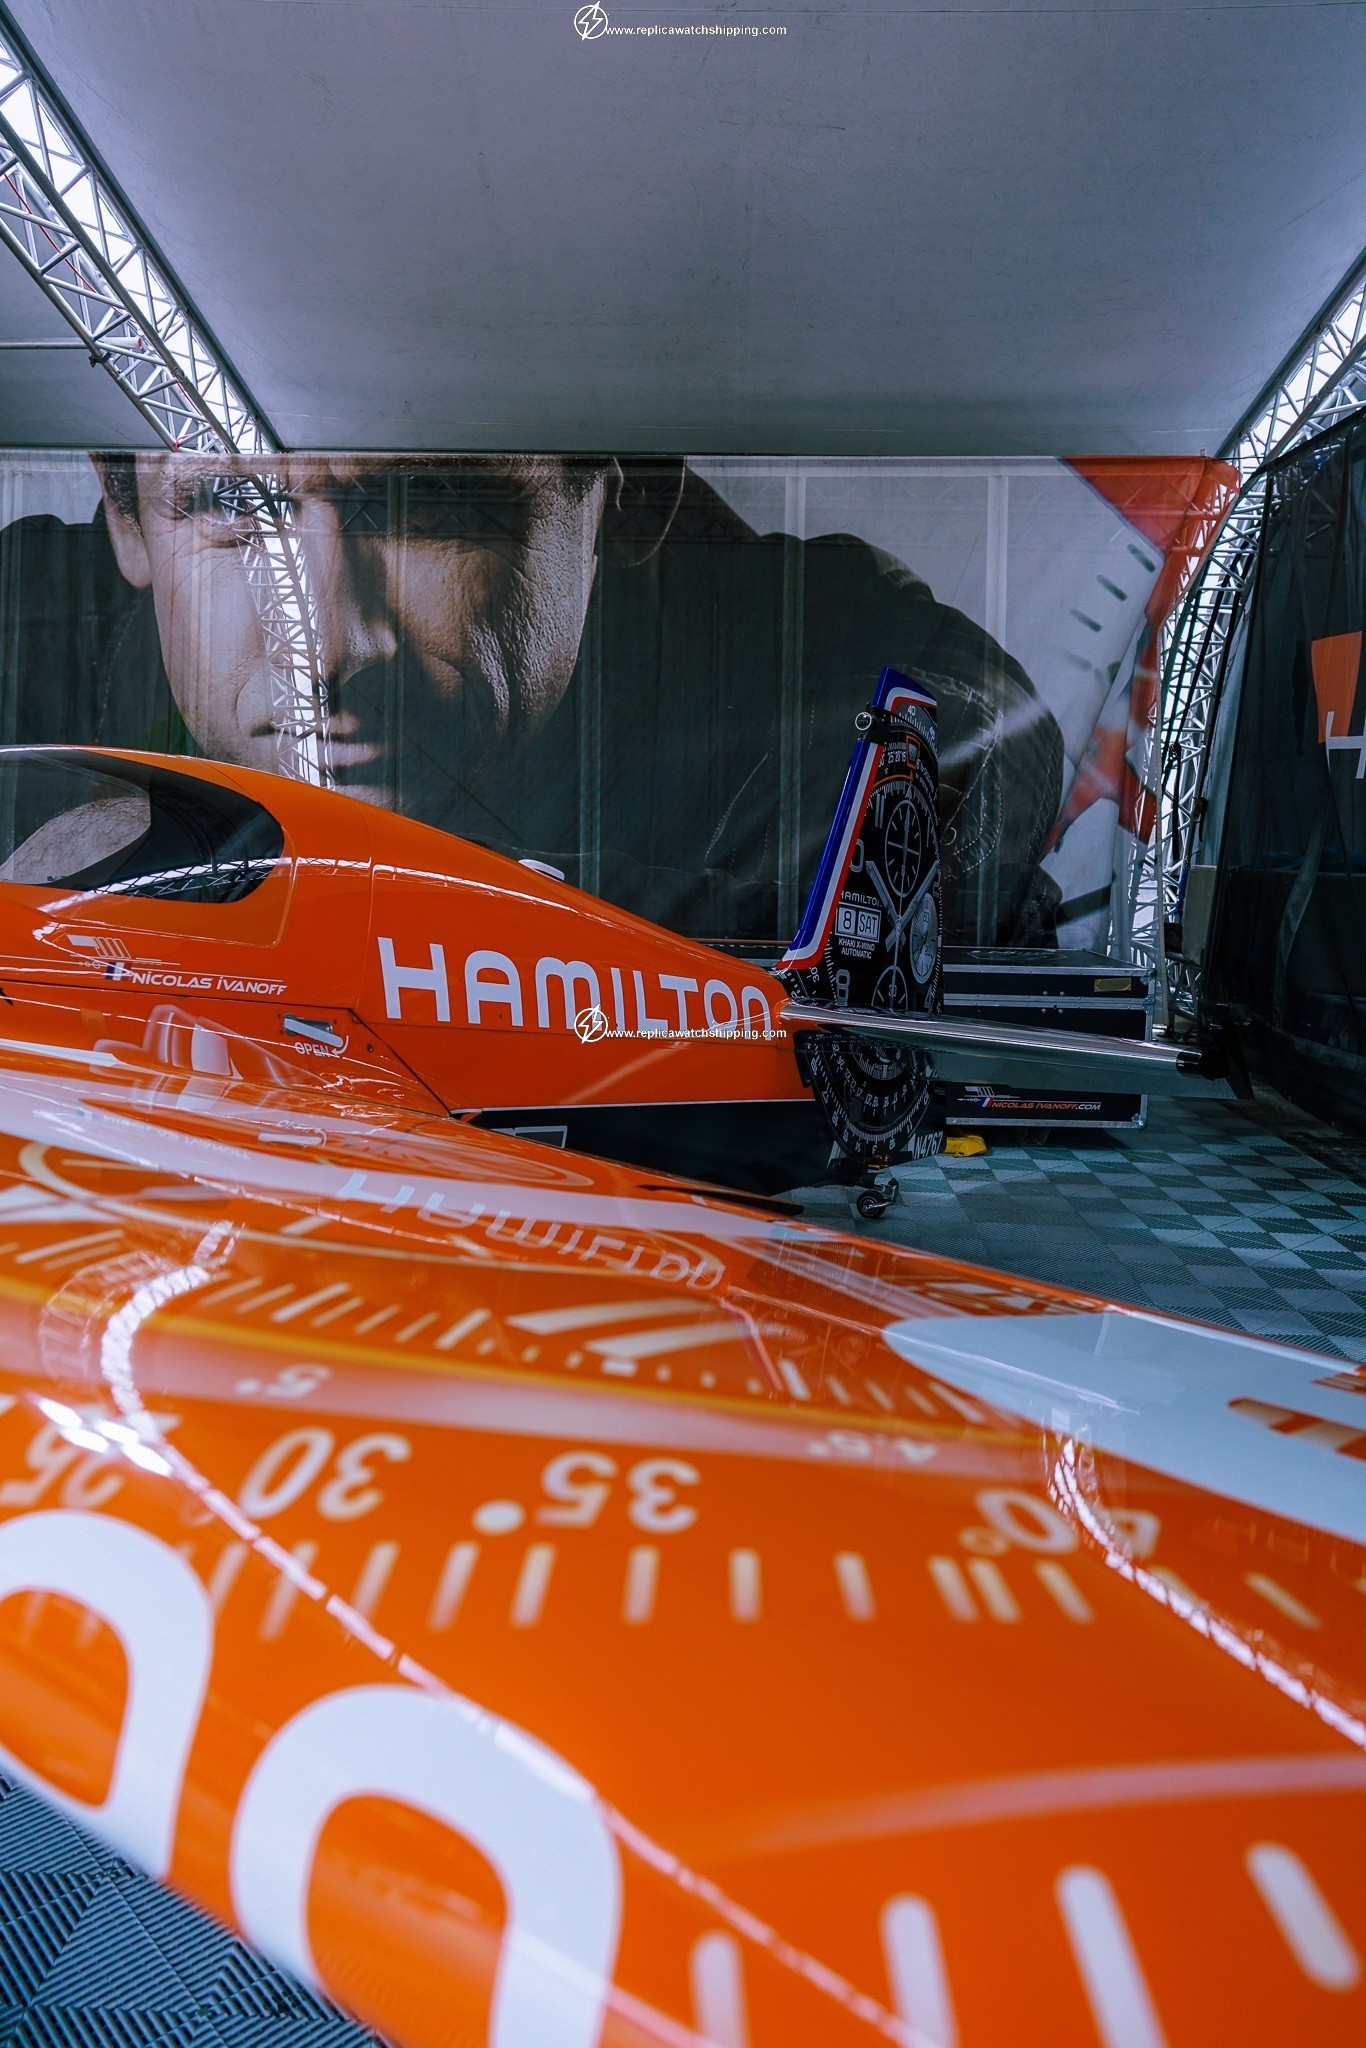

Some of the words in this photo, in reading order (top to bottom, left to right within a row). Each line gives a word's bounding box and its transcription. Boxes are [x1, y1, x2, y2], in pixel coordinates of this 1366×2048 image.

[843, 910, 852, 930] 8
[859, 914, 878, 935] SAT
[838, 938, 856, 948] KHAKI
[841, 947, 872, 960] AUTOMATIC
[131, 969, 212, 990] NICOLAS
[216, 975, 288, 996] IVANOFF
[377, 936, 773, 1042] HAMILTON
[295, 1042, 330, 1058] OPEN
[991, 1101, 1034, 1109] NICOLAS
[1035, 1101, 1101, 1111] IVANOFF.COM
